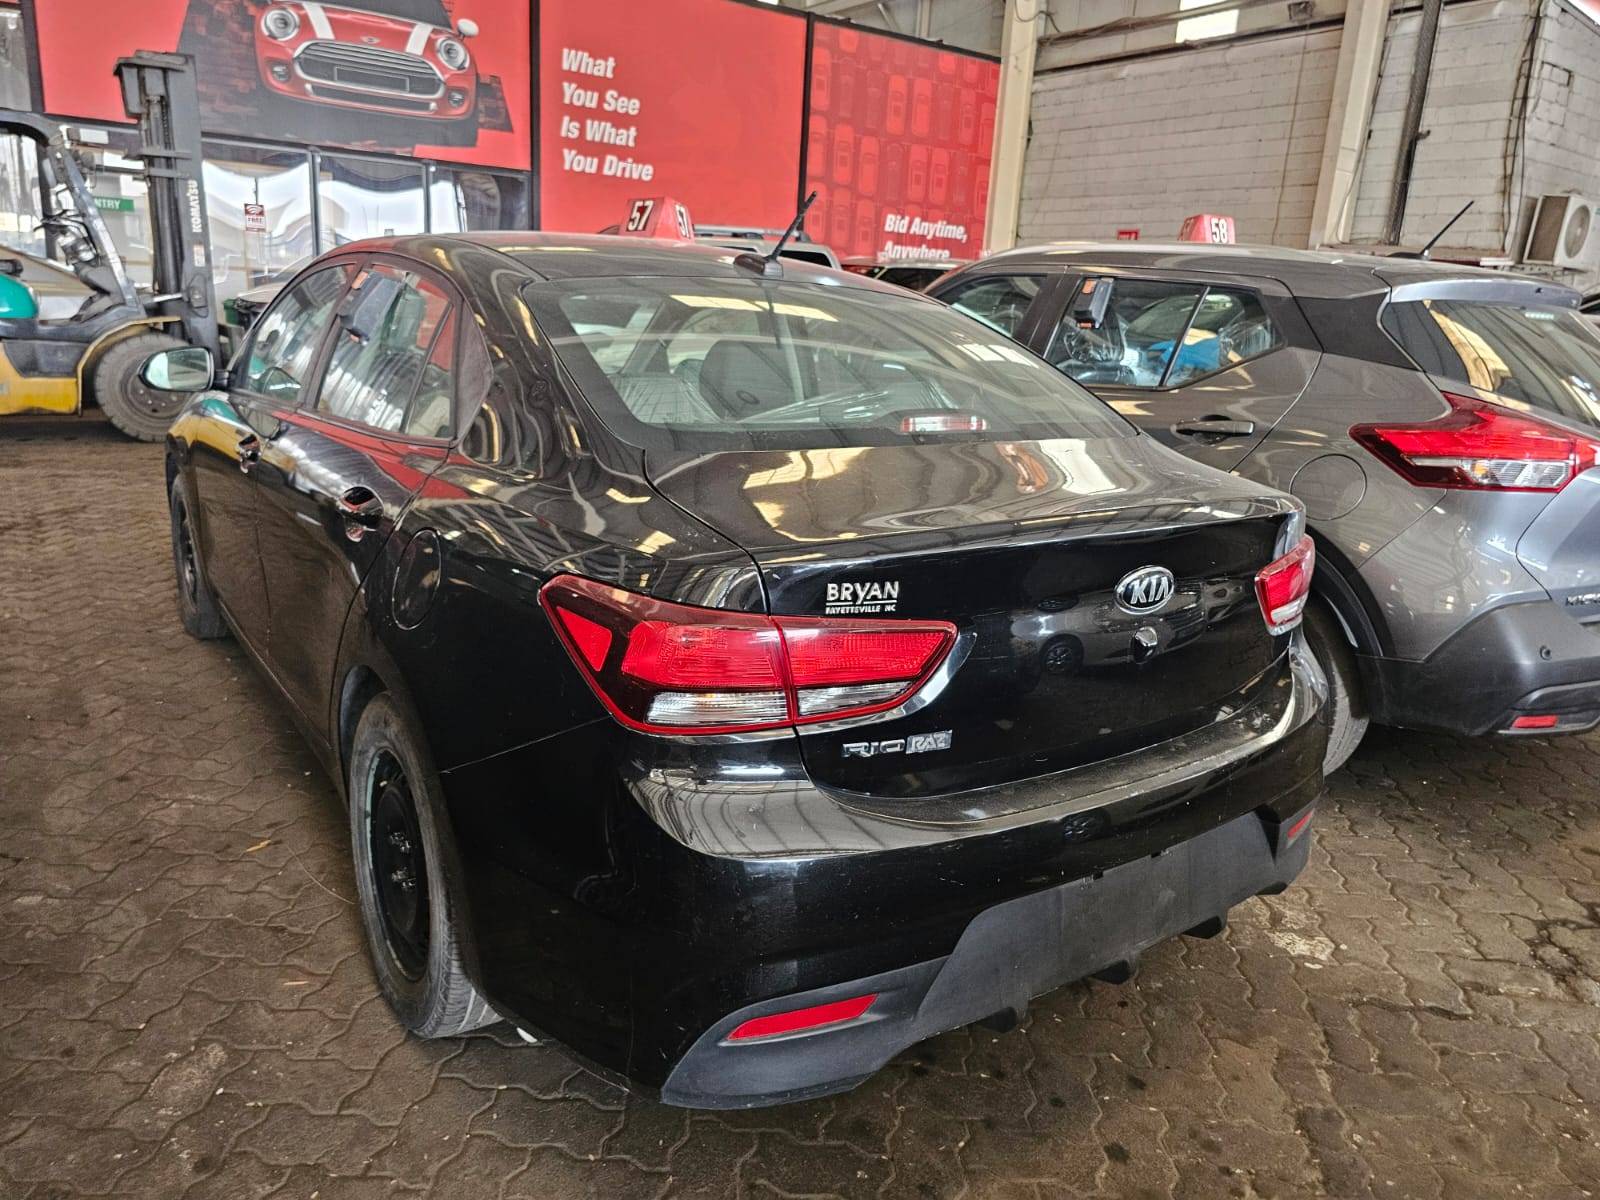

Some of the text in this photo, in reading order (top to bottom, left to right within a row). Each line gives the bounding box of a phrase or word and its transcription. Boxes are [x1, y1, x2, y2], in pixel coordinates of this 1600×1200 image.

[562, 48, 615, 78] What
[562, 82, 640, 115] You See
[561, 115, 637, 147] Is What
[562, 148, 654, 181] You Drive
[186, 180, 202, 232] KOMATSU
[627, 200, 654, 231] 57
[884, 214, 968, 243] Bid Anytime,
[1210, 217, 1228, 243] 58
[826, 581, 899, 605] BRYAN
[1129, 575, 1169, 604] KIA
[884, 604, 896, 612] NC
[842, 739, 905, 757] RIO
